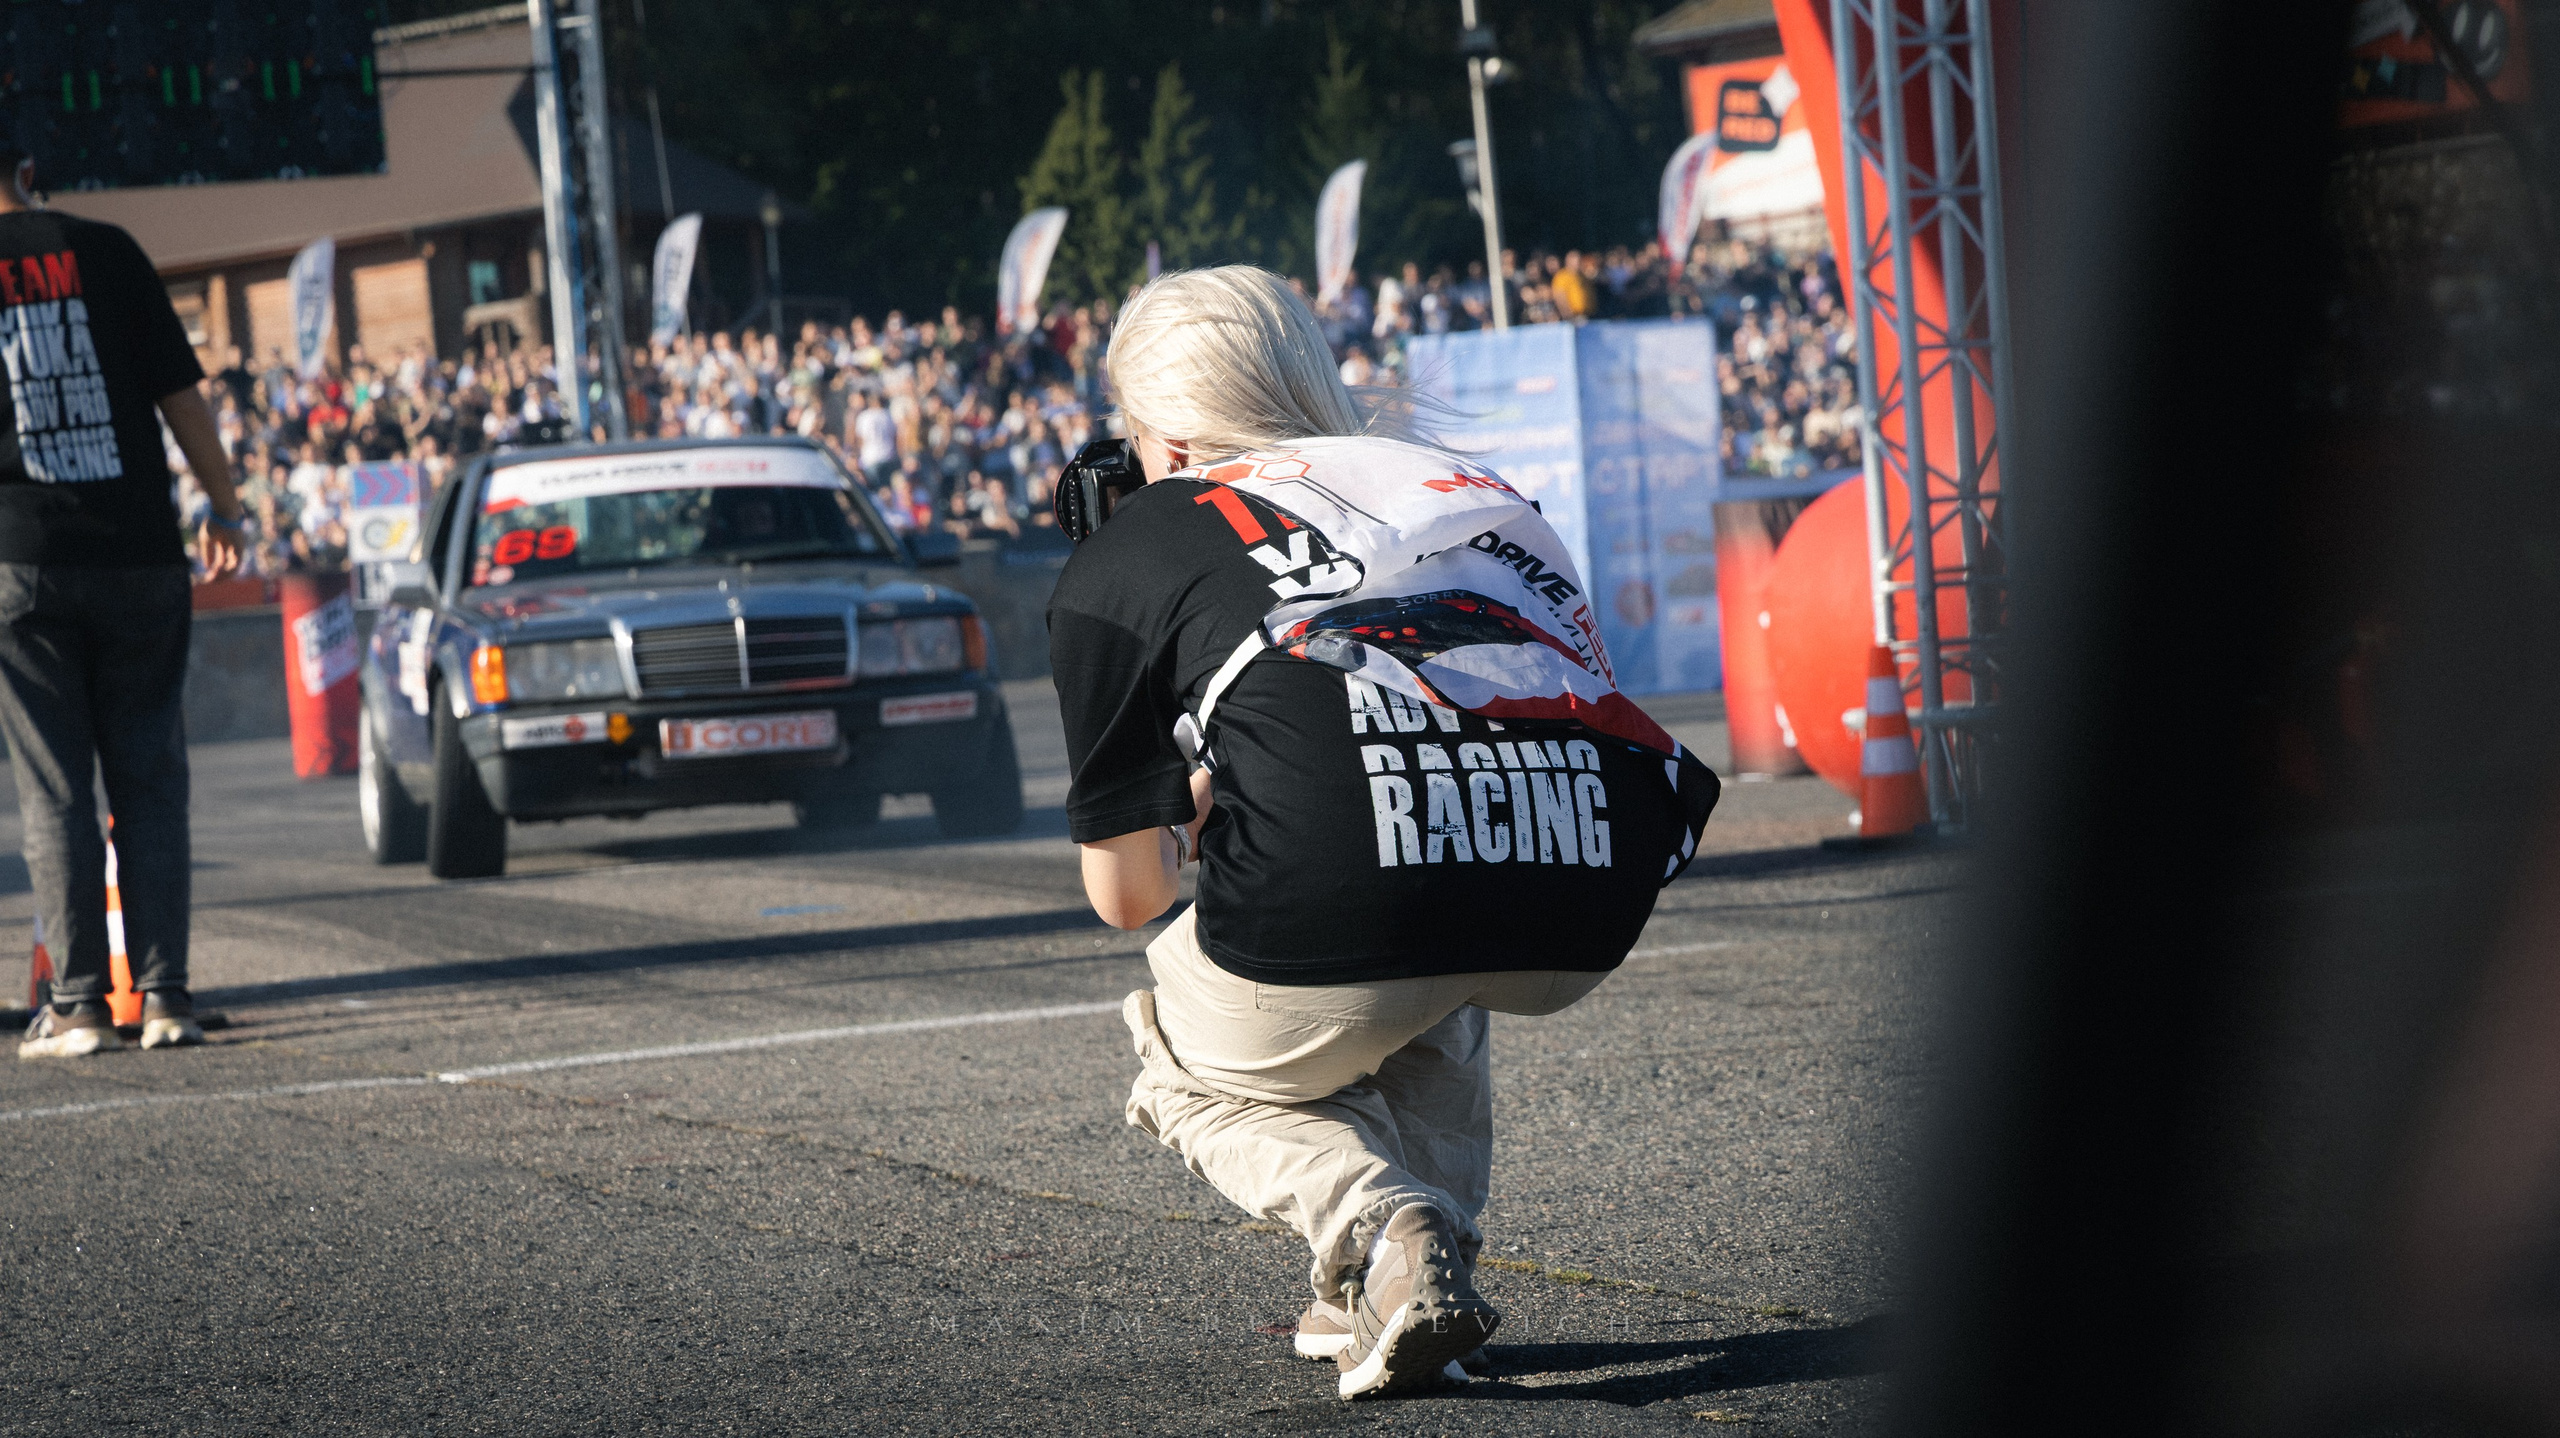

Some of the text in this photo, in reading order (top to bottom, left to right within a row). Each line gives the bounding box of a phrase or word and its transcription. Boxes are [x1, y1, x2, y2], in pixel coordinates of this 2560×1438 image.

[19, 432, 123, 483] RACING
[493, 525, 578, 567] 69
[1467, 529, 1580, 606] DRIVE
[1396, 590, 1468, 607] SORRY
[1364, 760, 1612, 868] RACING
